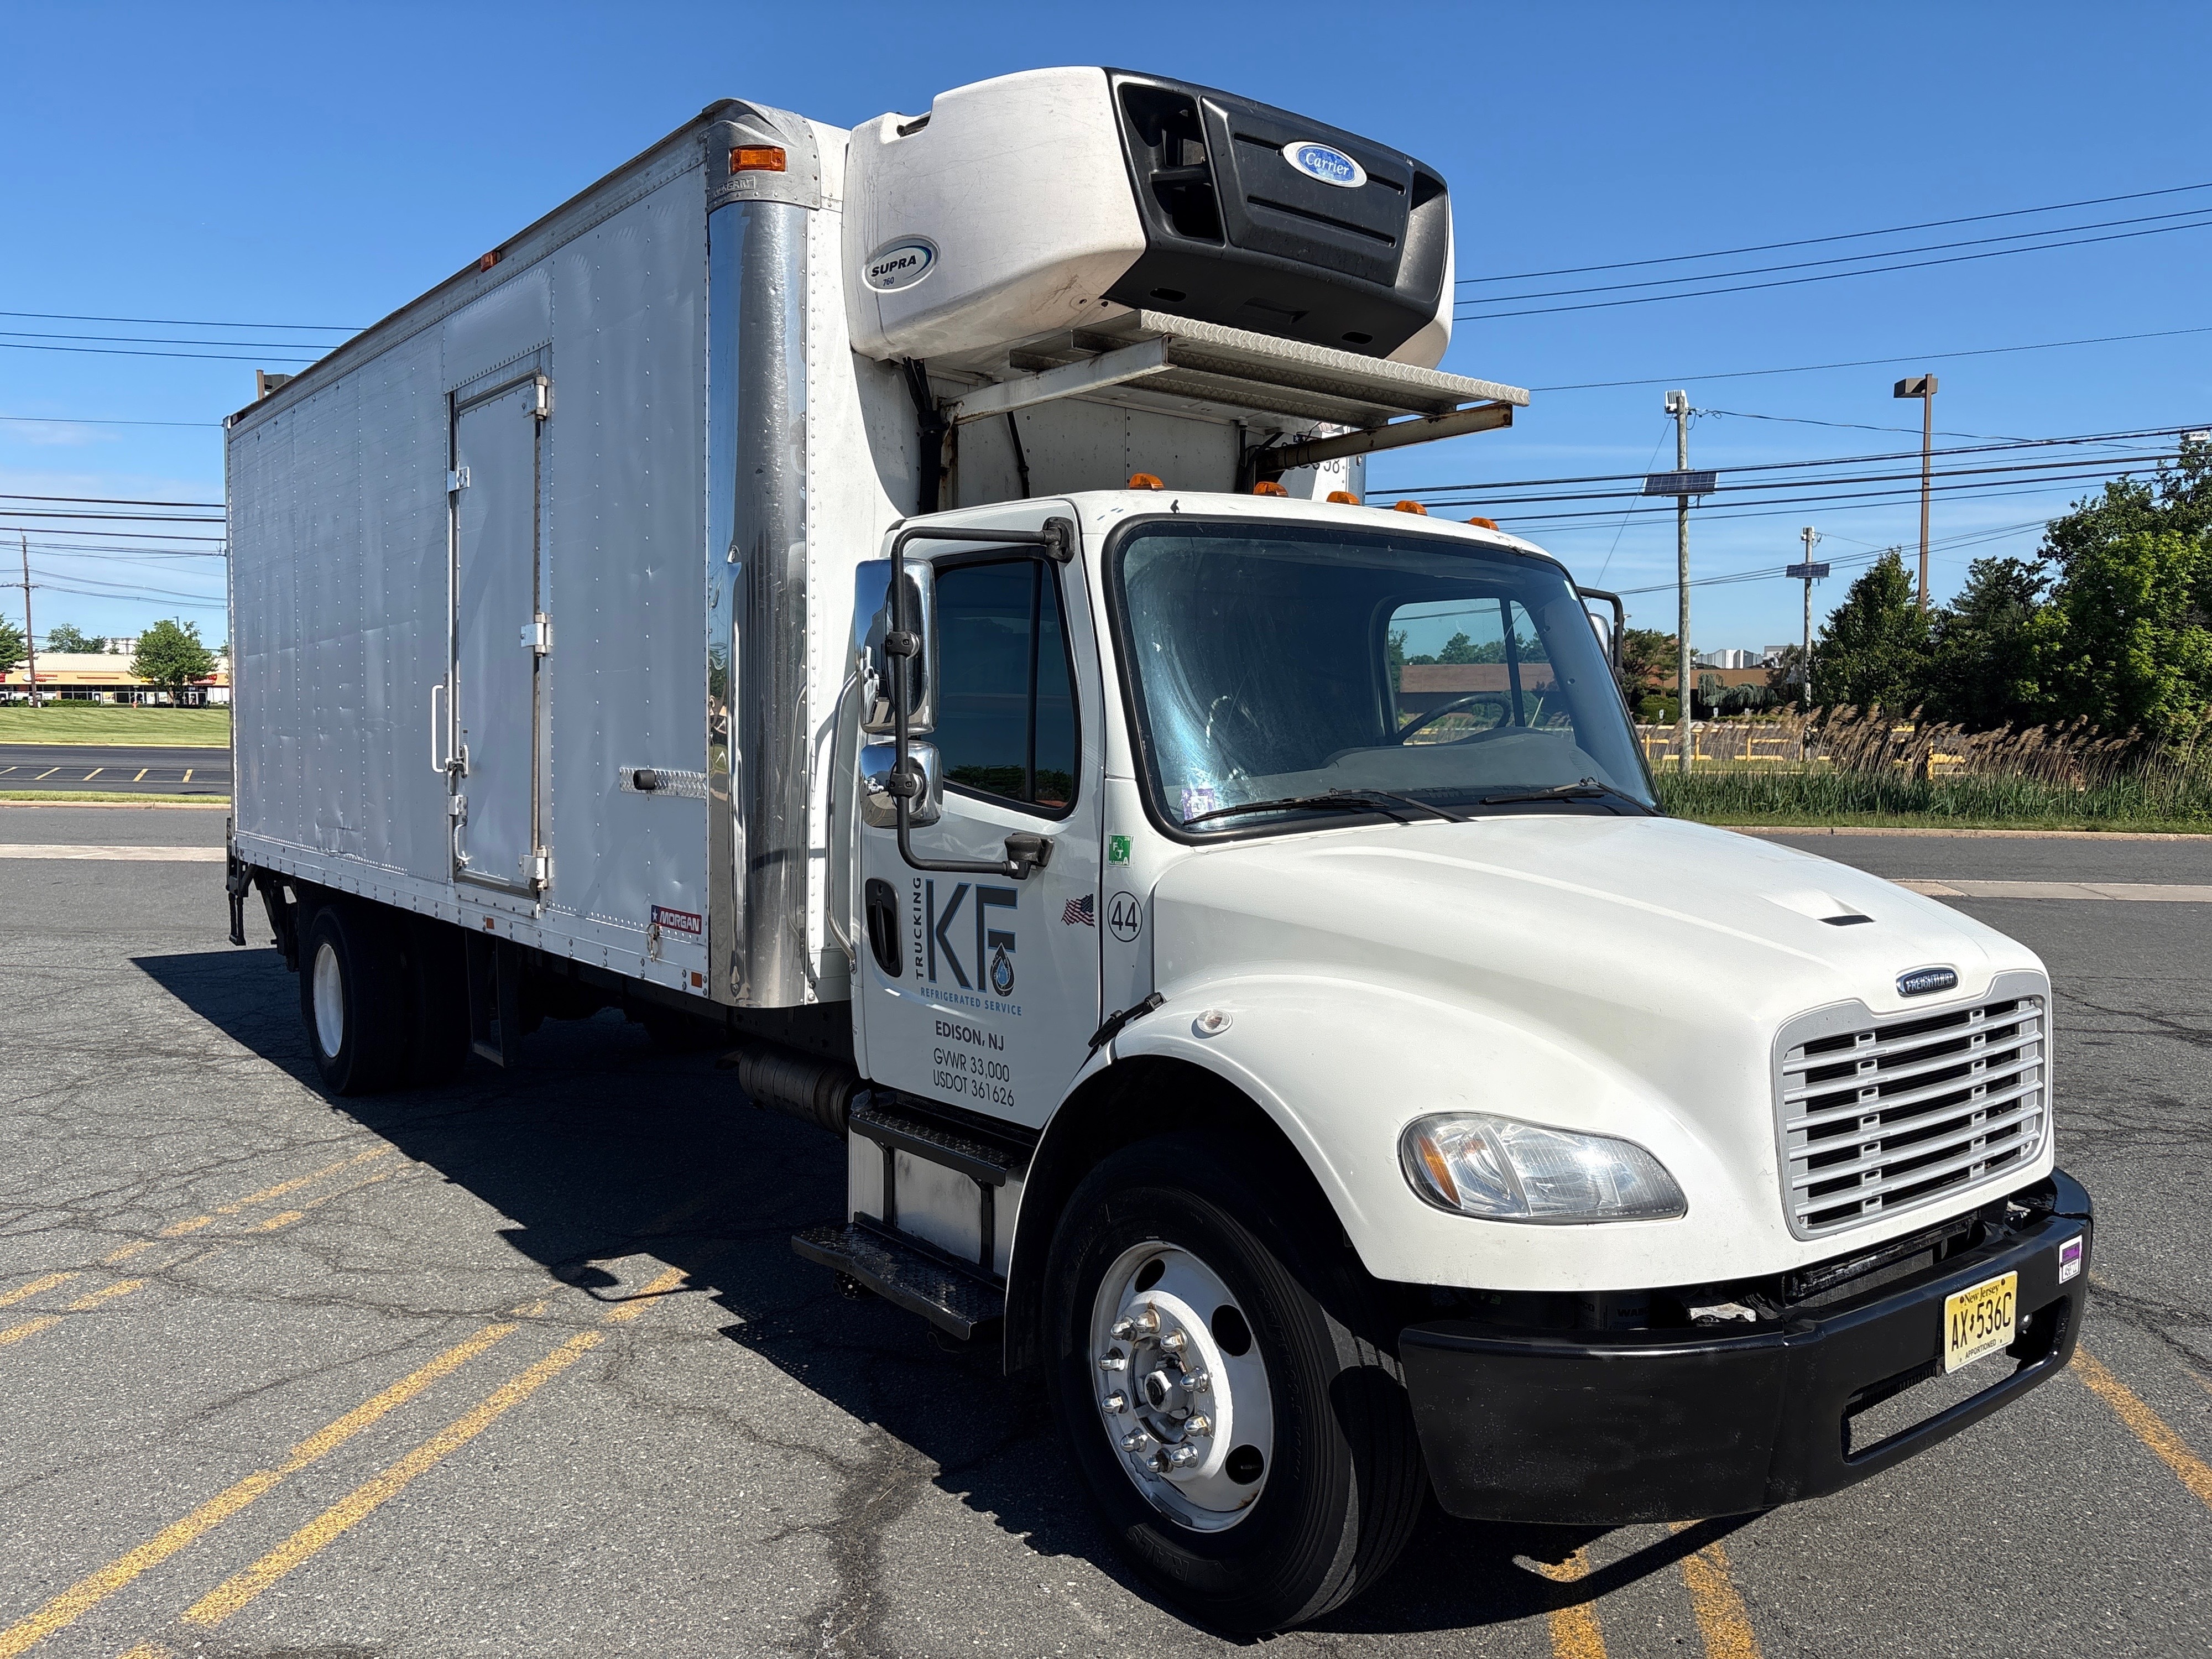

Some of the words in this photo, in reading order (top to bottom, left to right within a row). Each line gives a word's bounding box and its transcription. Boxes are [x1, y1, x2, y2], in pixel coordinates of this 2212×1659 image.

[1305, 152, 1350, 176] Carrier
[870, 254, 917, 278] SUPRA
[883, 276, 895, 287] 760
[660, 911, 700, 932] MORGAN
[912, 877, 925, 980] TRUCKING
[1111, 900, 1138, 933] 44
[925, 878, 1018, 993] KF
[920, 986, 982, 1008] REFRIGERATED
[984, 999, 1022, 1016] SERVICE
[935, 1020, 985, 1046] EDISON,
[988, 1031, 1005, 1052] NJ
[933, 1047, 967, 1072] GVWR
[970, 1056, 1010, 1083] 33,000
[933, 1068, 967, 1094] USDOT
[971, 1078, 1015, 1108] 361626
[1964, 1292, 1979, 1306] New
[1979, 1284, 2000, 1301] Jersey
[1965, 1338, 1997, 1360] APPORTIONED
